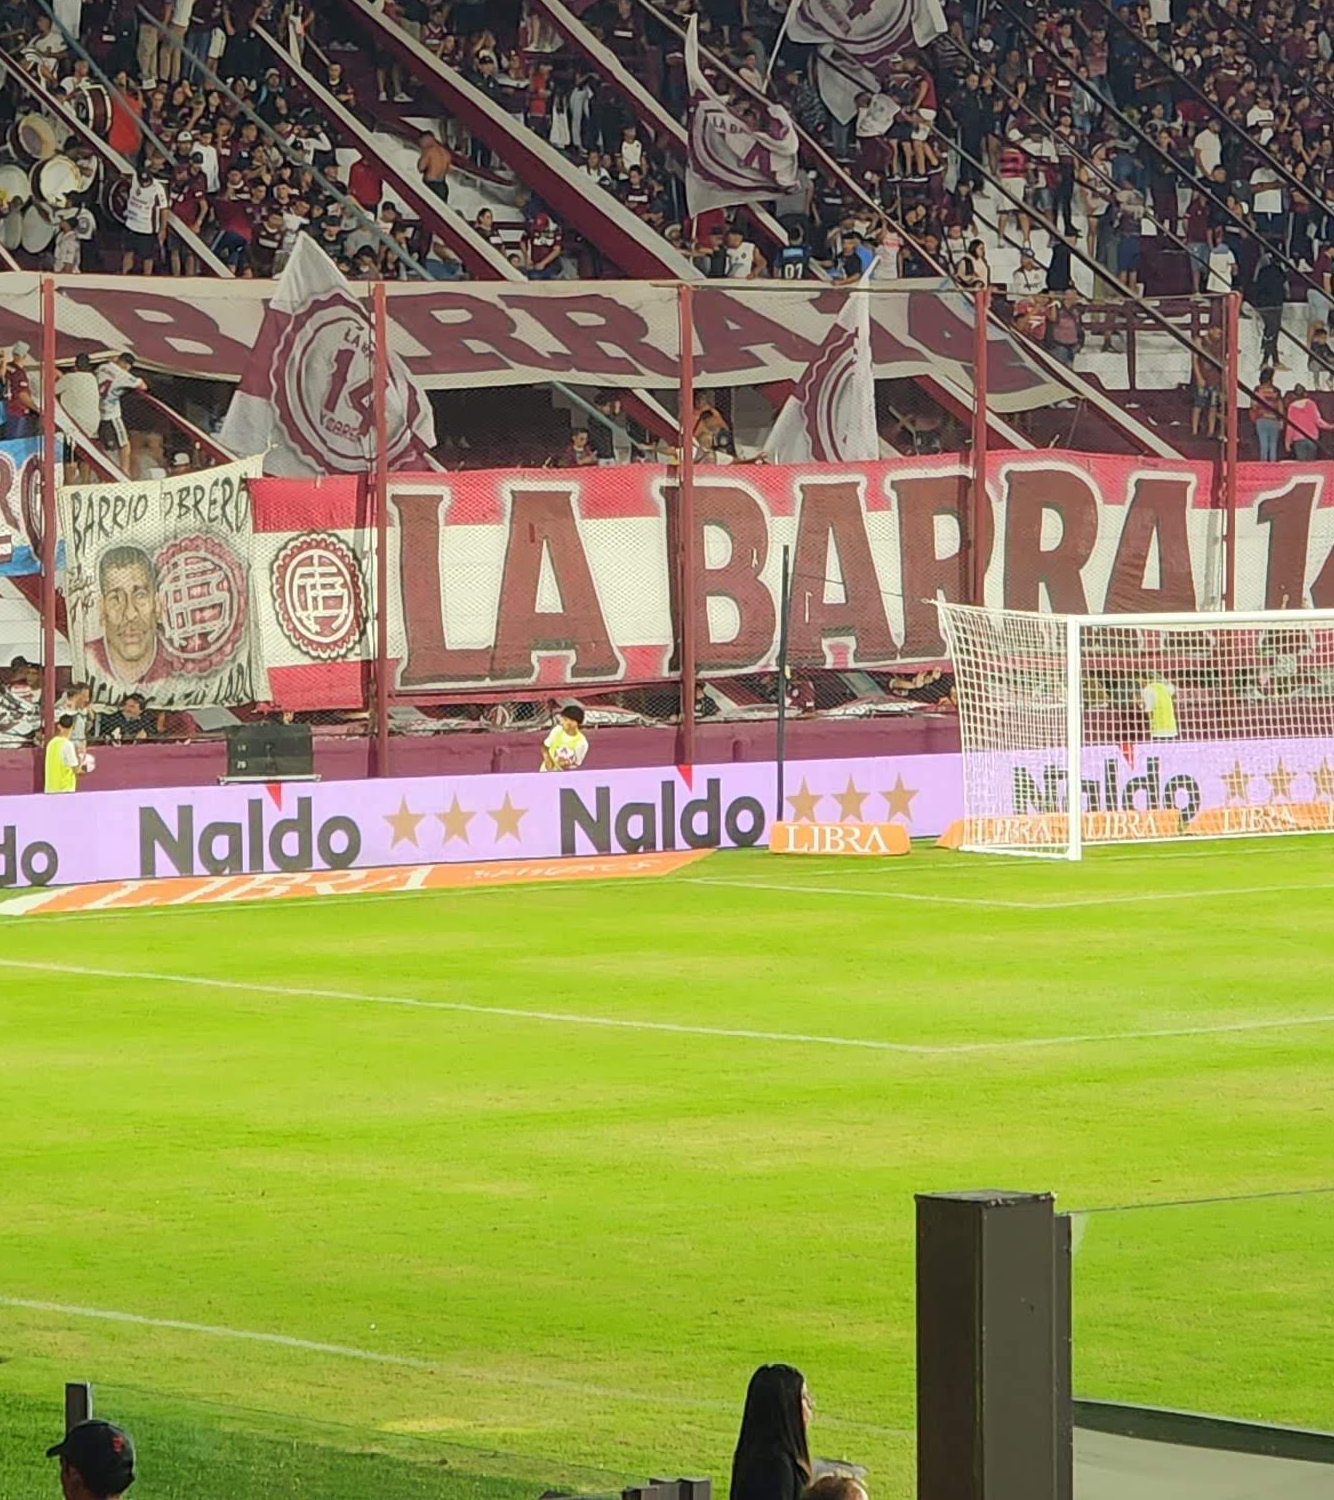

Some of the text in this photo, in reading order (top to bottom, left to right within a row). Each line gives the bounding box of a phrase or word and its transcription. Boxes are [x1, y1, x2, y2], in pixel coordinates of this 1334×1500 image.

[70, 490, 149, 548] BARRIO
[389, 484, 623, 689] LA
[657, 466, 1213, 676] BARRA
[140, 796, 362, 877] Naldo
[559, 777, 765, 856] Naldo
[784, 824, 889, 854] LIBRA
